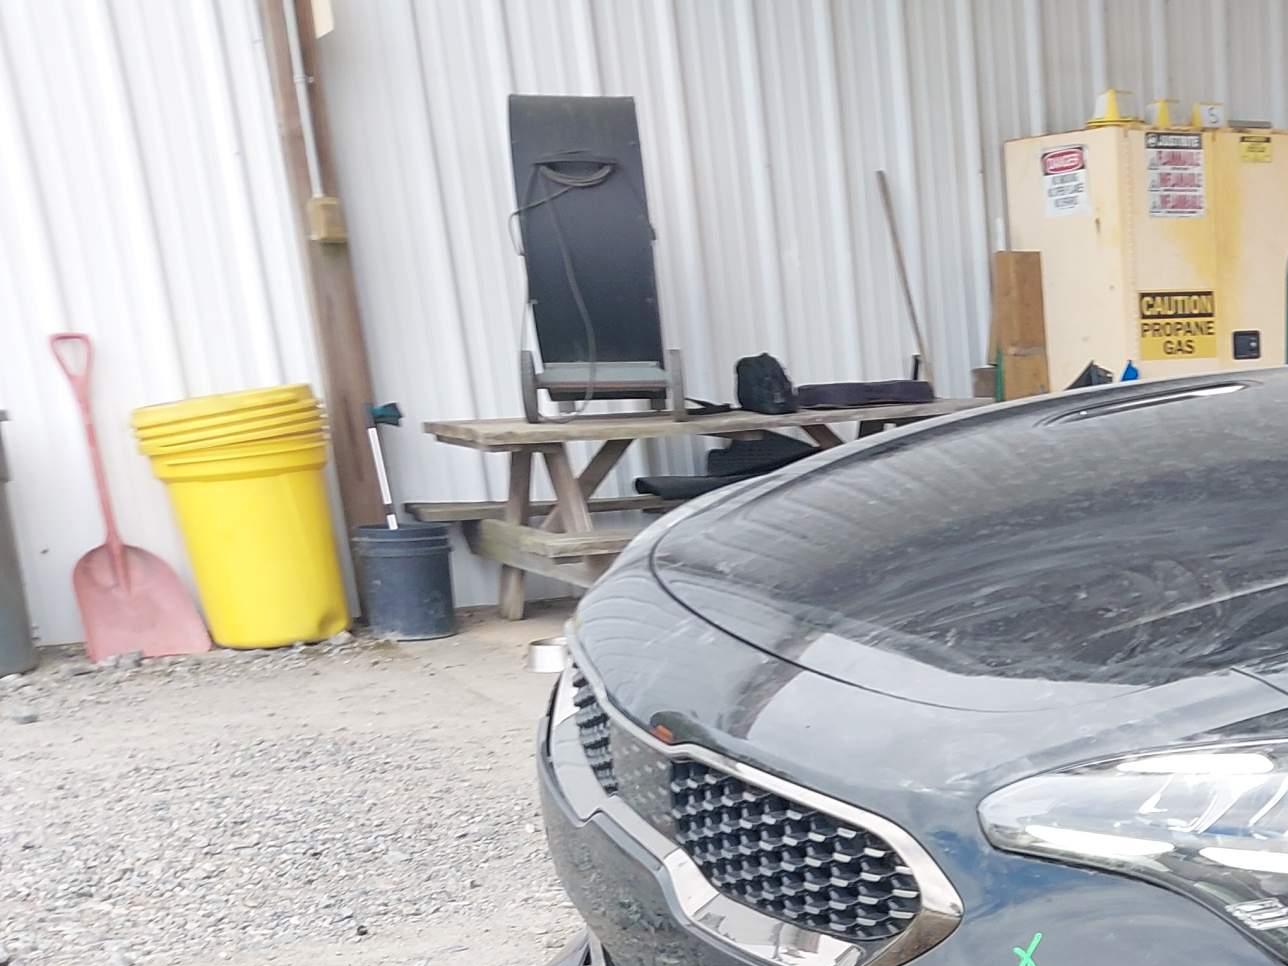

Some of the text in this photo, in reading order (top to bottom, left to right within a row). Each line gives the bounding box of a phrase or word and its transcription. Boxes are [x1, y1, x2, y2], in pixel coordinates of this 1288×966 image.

[1141, 295, 1215, 315] CAUTION
[1141, 320, 1215, 338] PROPANE
[1163, 339, 1195, 355] GAS
